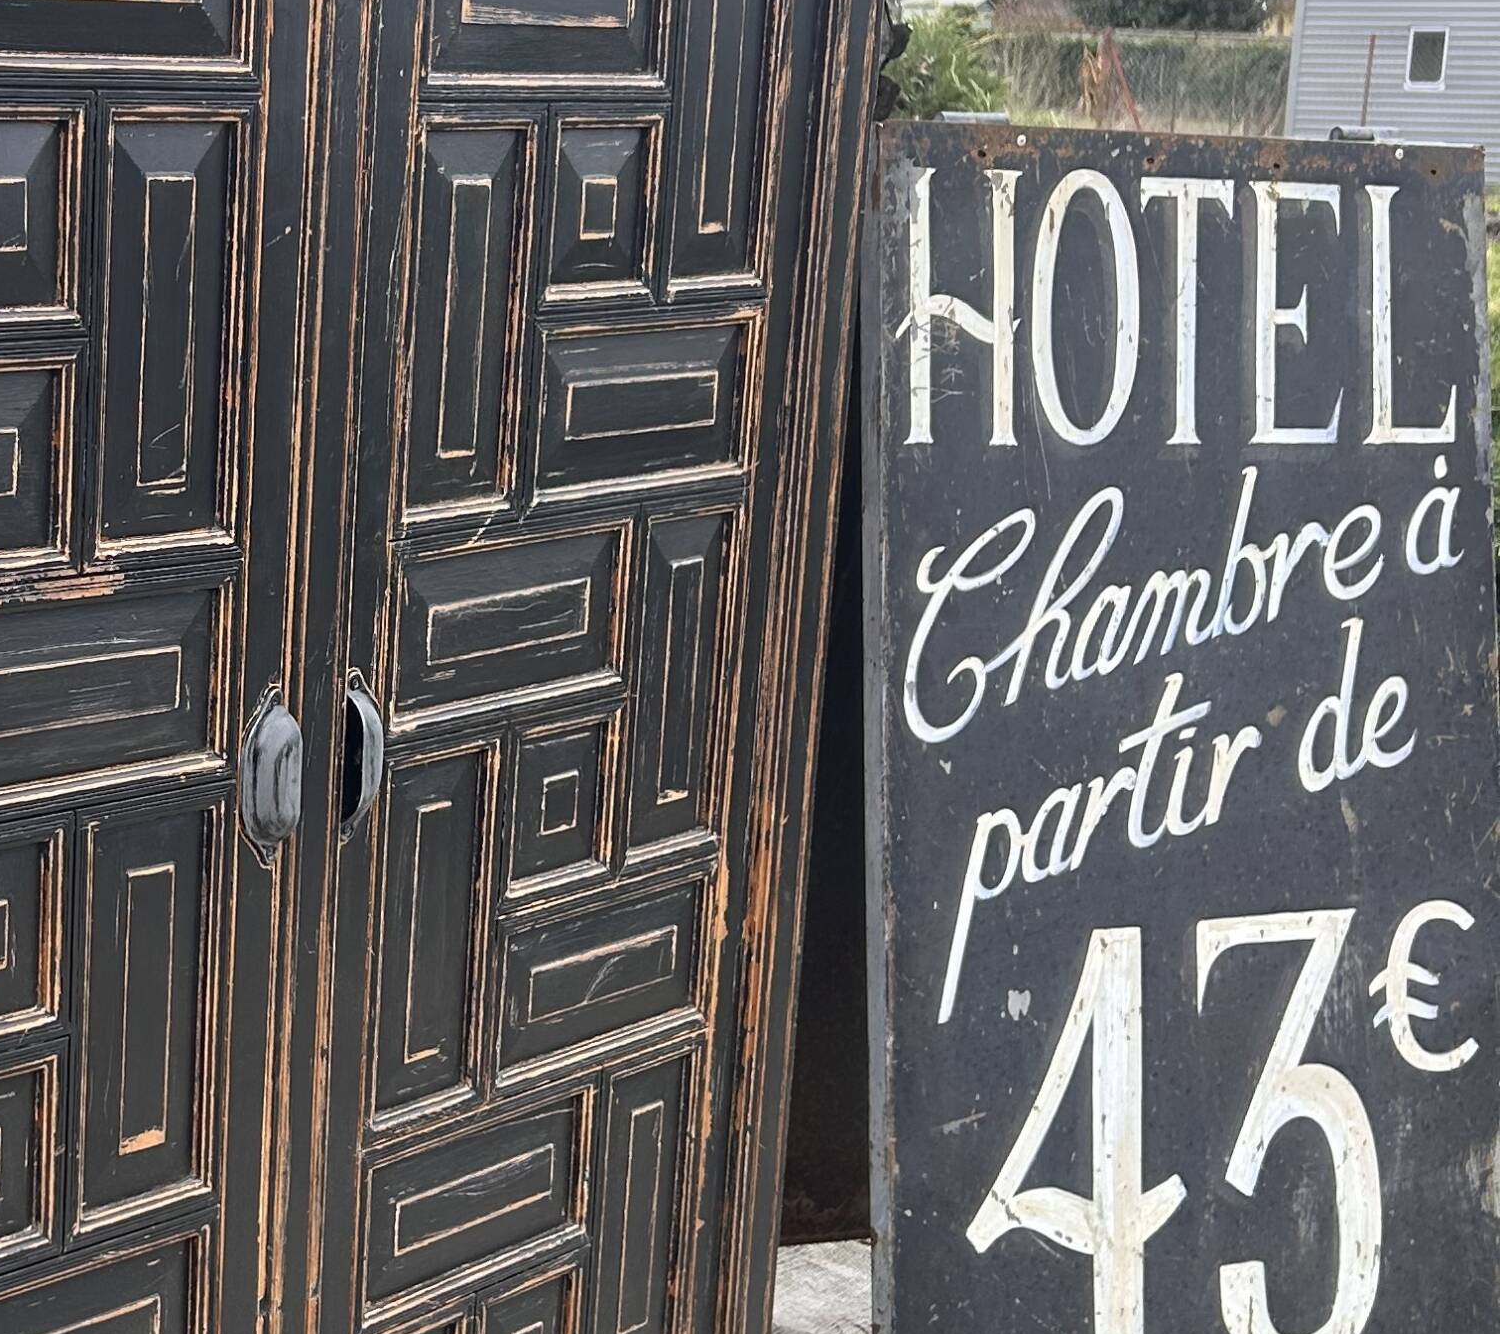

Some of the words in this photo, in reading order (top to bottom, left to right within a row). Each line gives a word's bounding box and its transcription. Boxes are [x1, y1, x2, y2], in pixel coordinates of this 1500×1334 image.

[894, 167, 1457, 446] HOTEL
[903, 466, 1385, 744] Chambre
[937, 672, 1263, 1025] partir
[1298, 617, 1418, 793] de
